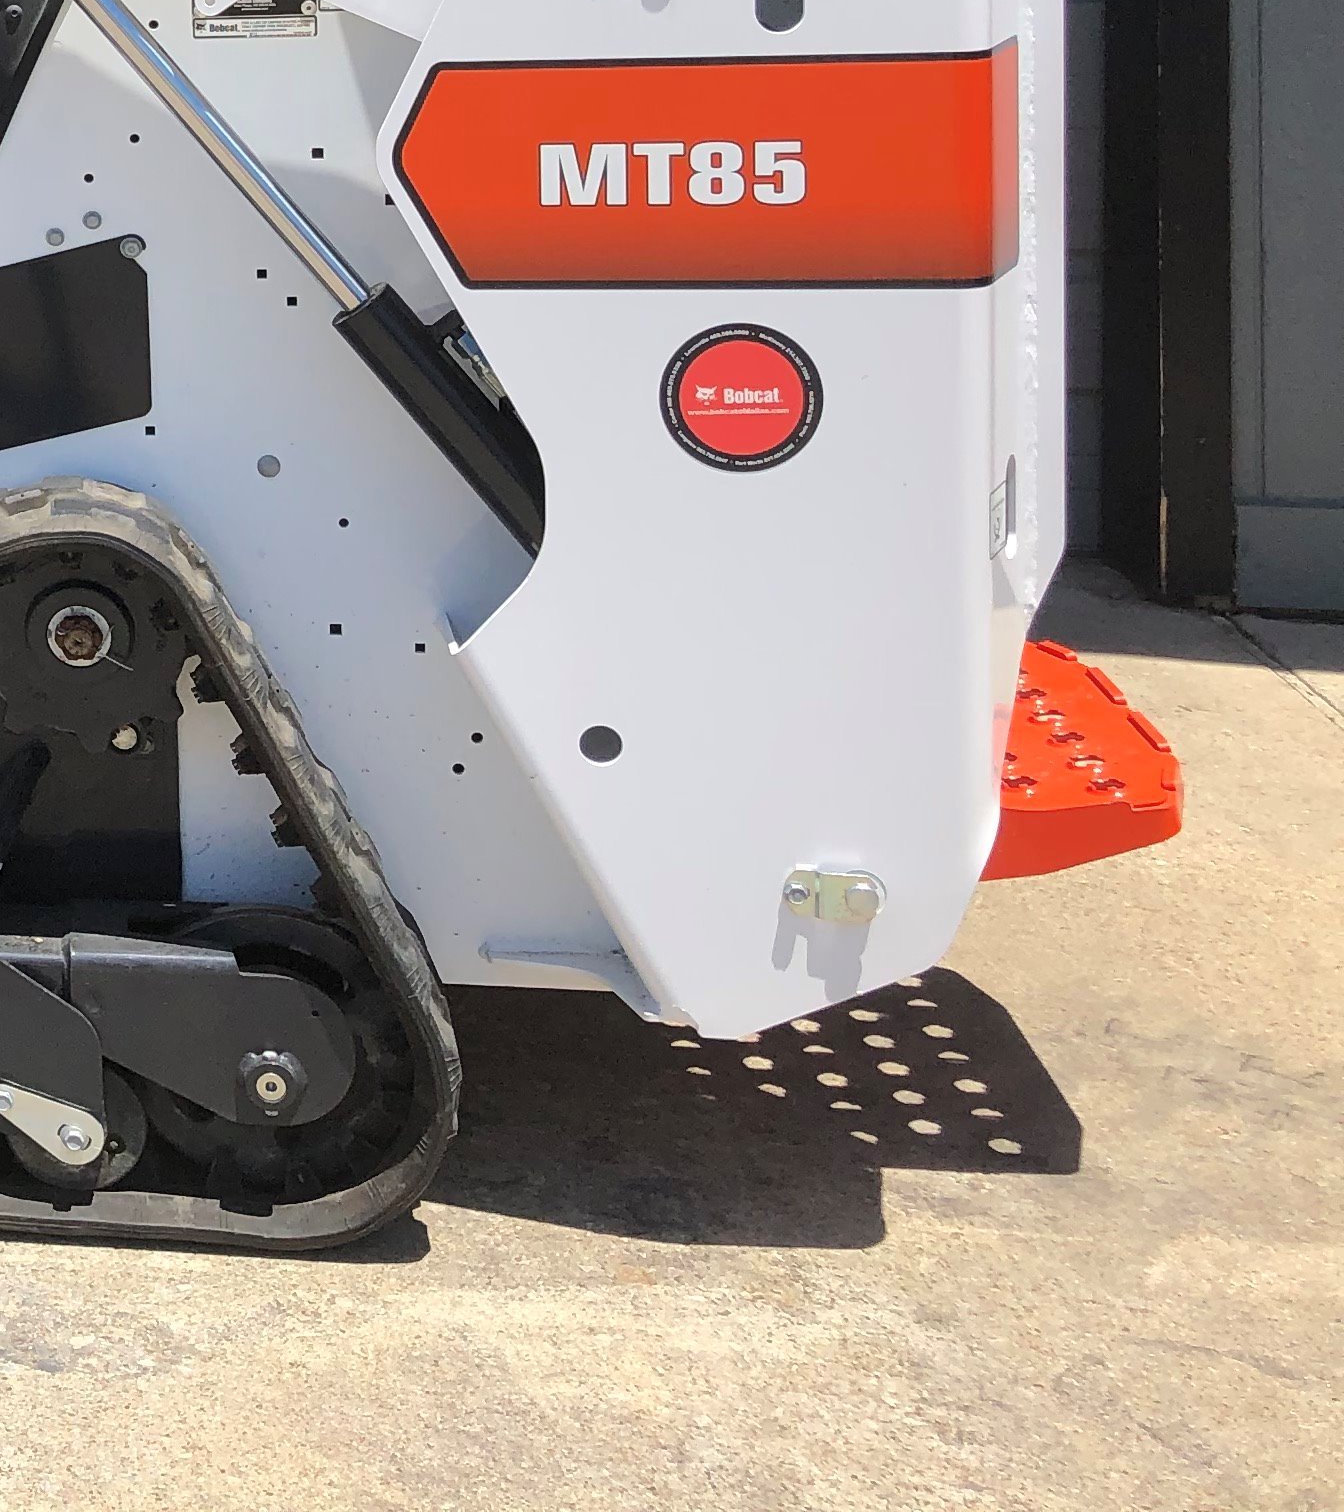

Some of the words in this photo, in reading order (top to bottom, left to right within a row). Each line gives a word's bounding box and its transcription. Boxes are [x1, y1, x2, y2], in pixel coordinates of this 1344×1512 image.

[209, 23, 239, 33] Bobcat
[538, 140, 807, 207] MT85
[723, 387, 780, 404] Bobcat
